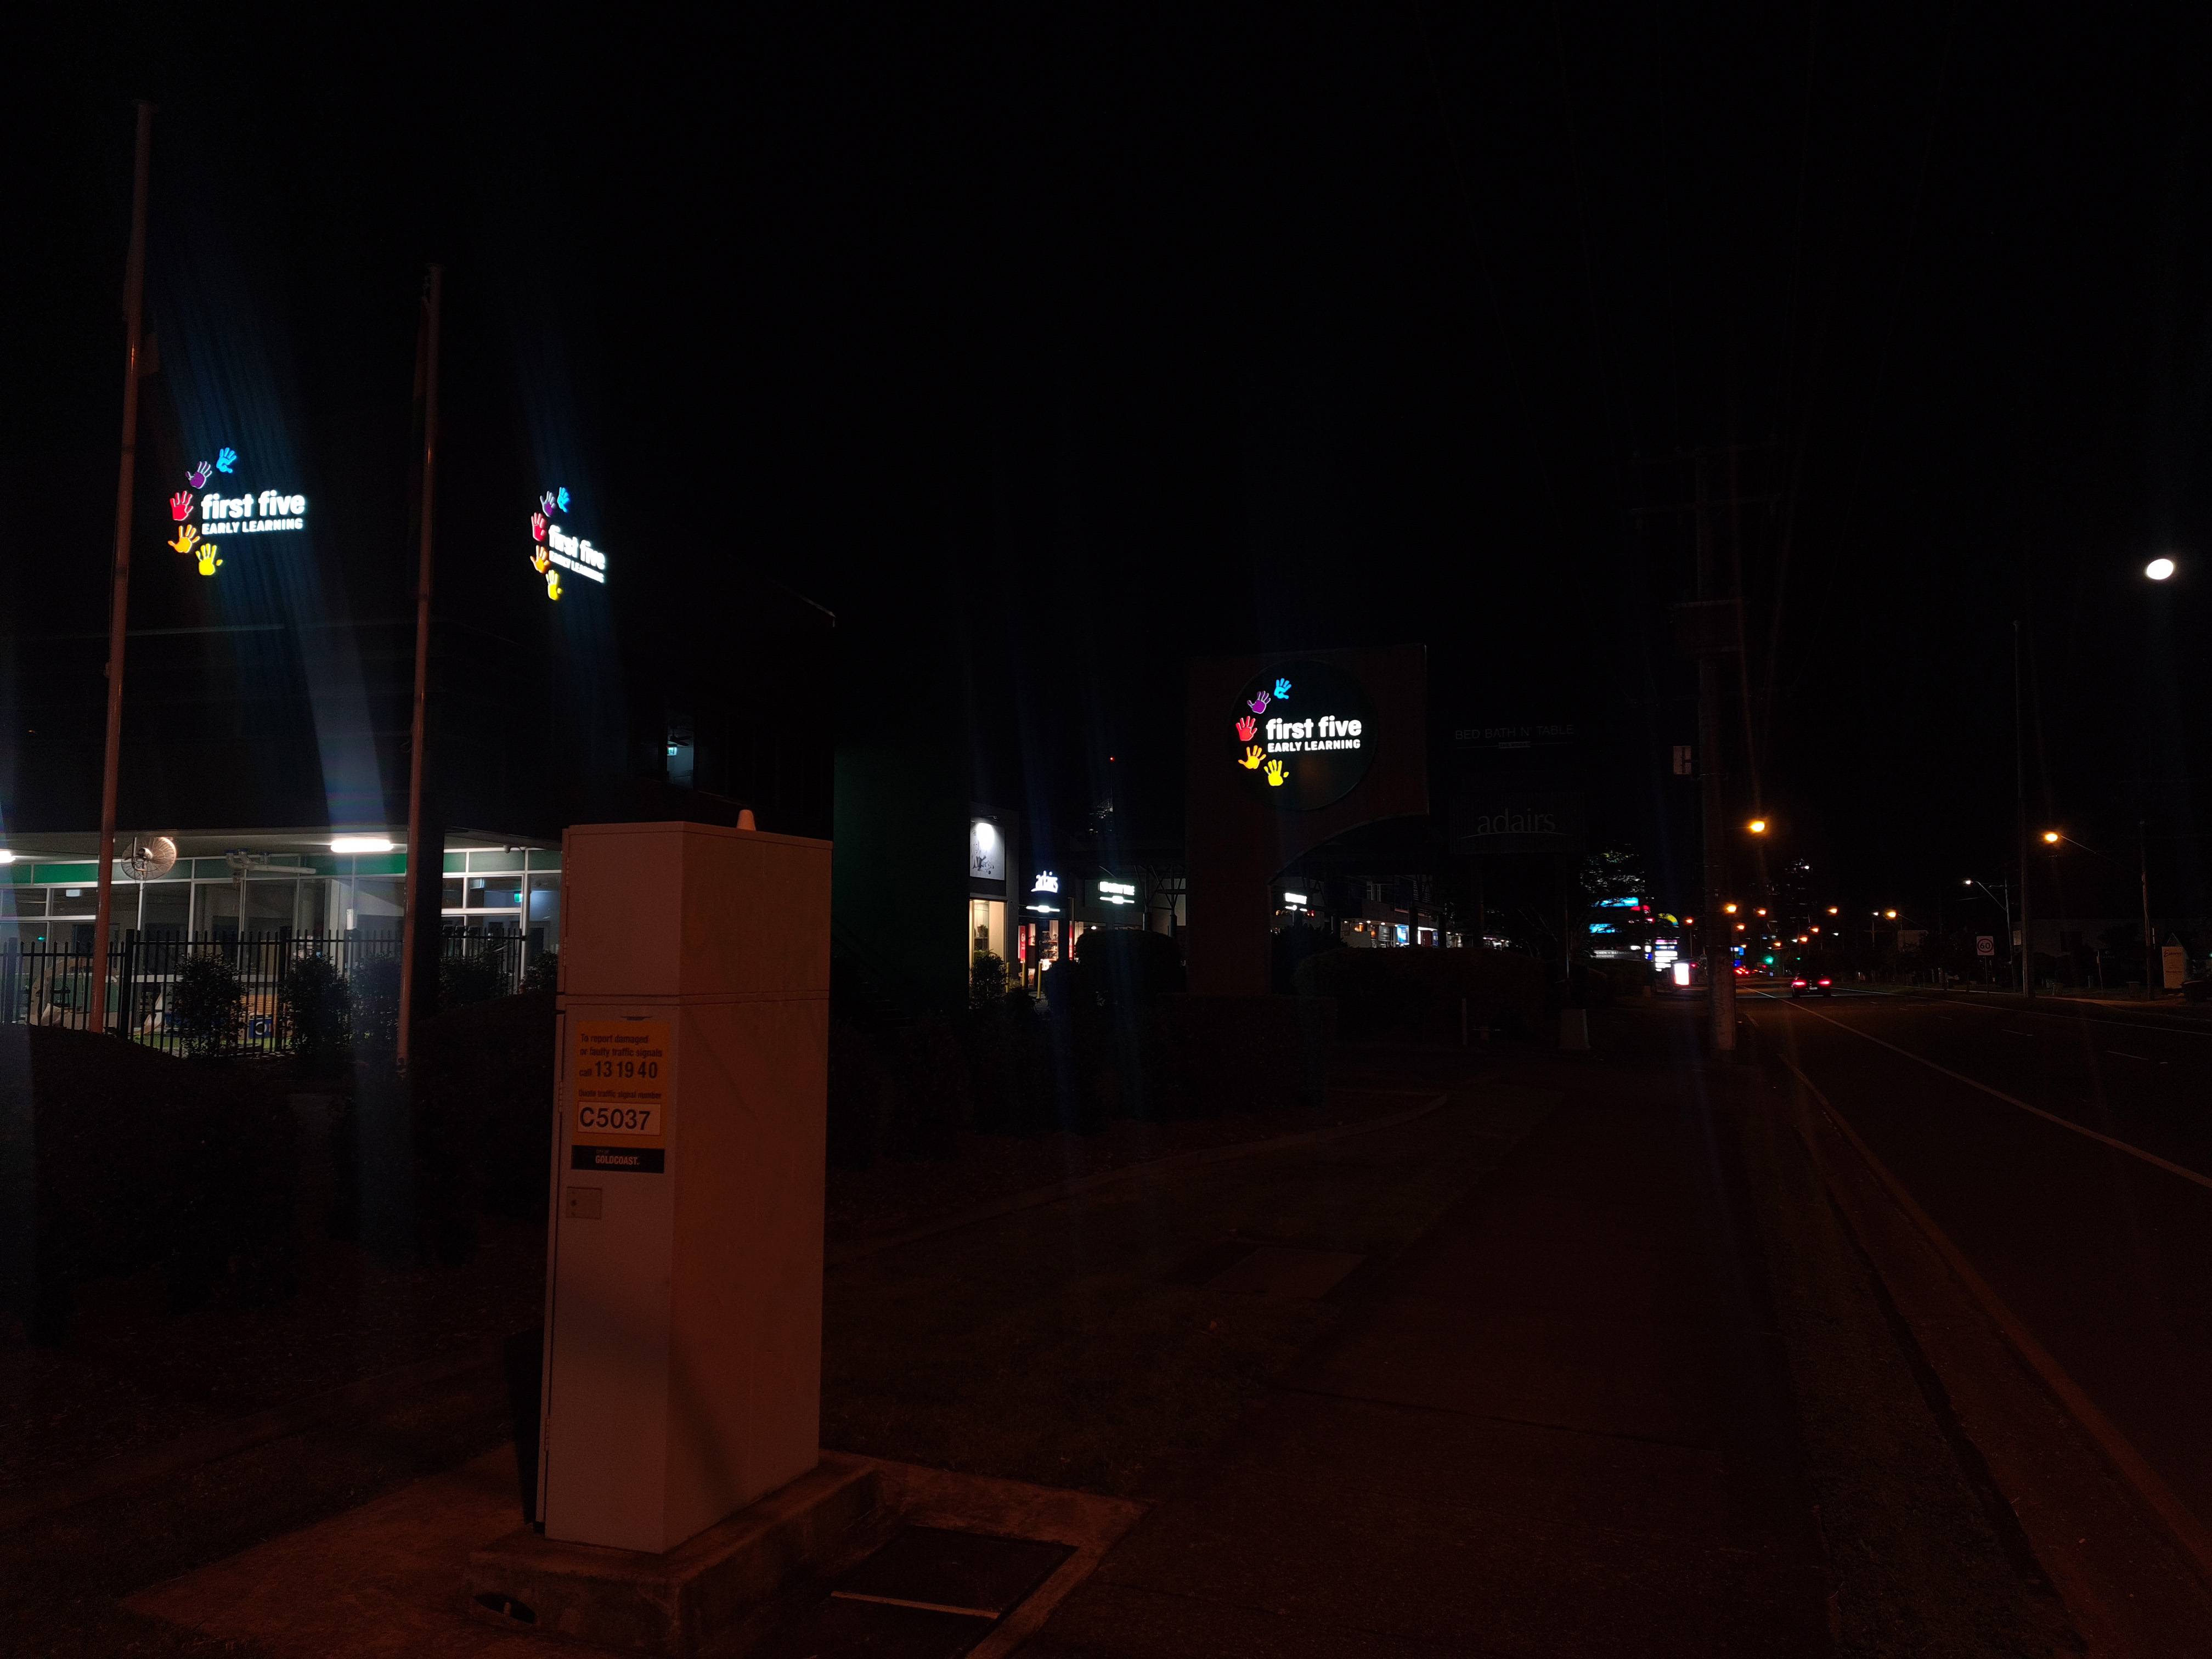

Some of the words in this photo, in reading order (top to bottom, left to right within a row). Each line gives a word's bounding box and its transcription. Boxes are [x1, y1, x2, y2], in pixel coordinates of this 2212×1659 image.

[201, 493, 254, 520] first
[258, 489, 305, 516] five
[201, 522, 240, 535] EARLY
[242, 518, 303, 533] LEARNING
[549, 524, 579, 558] first
[579, 539, 606, 570] five
[1266, 718, 1314, 740] first
[1318, 715, 1362, 737] five
[1455, 729, 1480, 740] BED
[1485, 727, 1516, 738] BATH
[1536, 724, 1573, 736] TABLE
[1267, 742, 1302, 753] EARLY
[1305, 739, 1361, 751] LEARNING
[1477, 808, 1556, 833] adairs
[580, 1033, 589, 1042] To
[590, 1035, 612, 1044] report
[614, 1034, 648, 1045] damaged
[589, 1047, 610, 1058] faulty
[612, 1048, 634, 1057] traffic
[635, 1048, 662, 1059] signals
[597, 1089, 616, 1098] traffic
[579, 1107, 650, 1130] C5037
